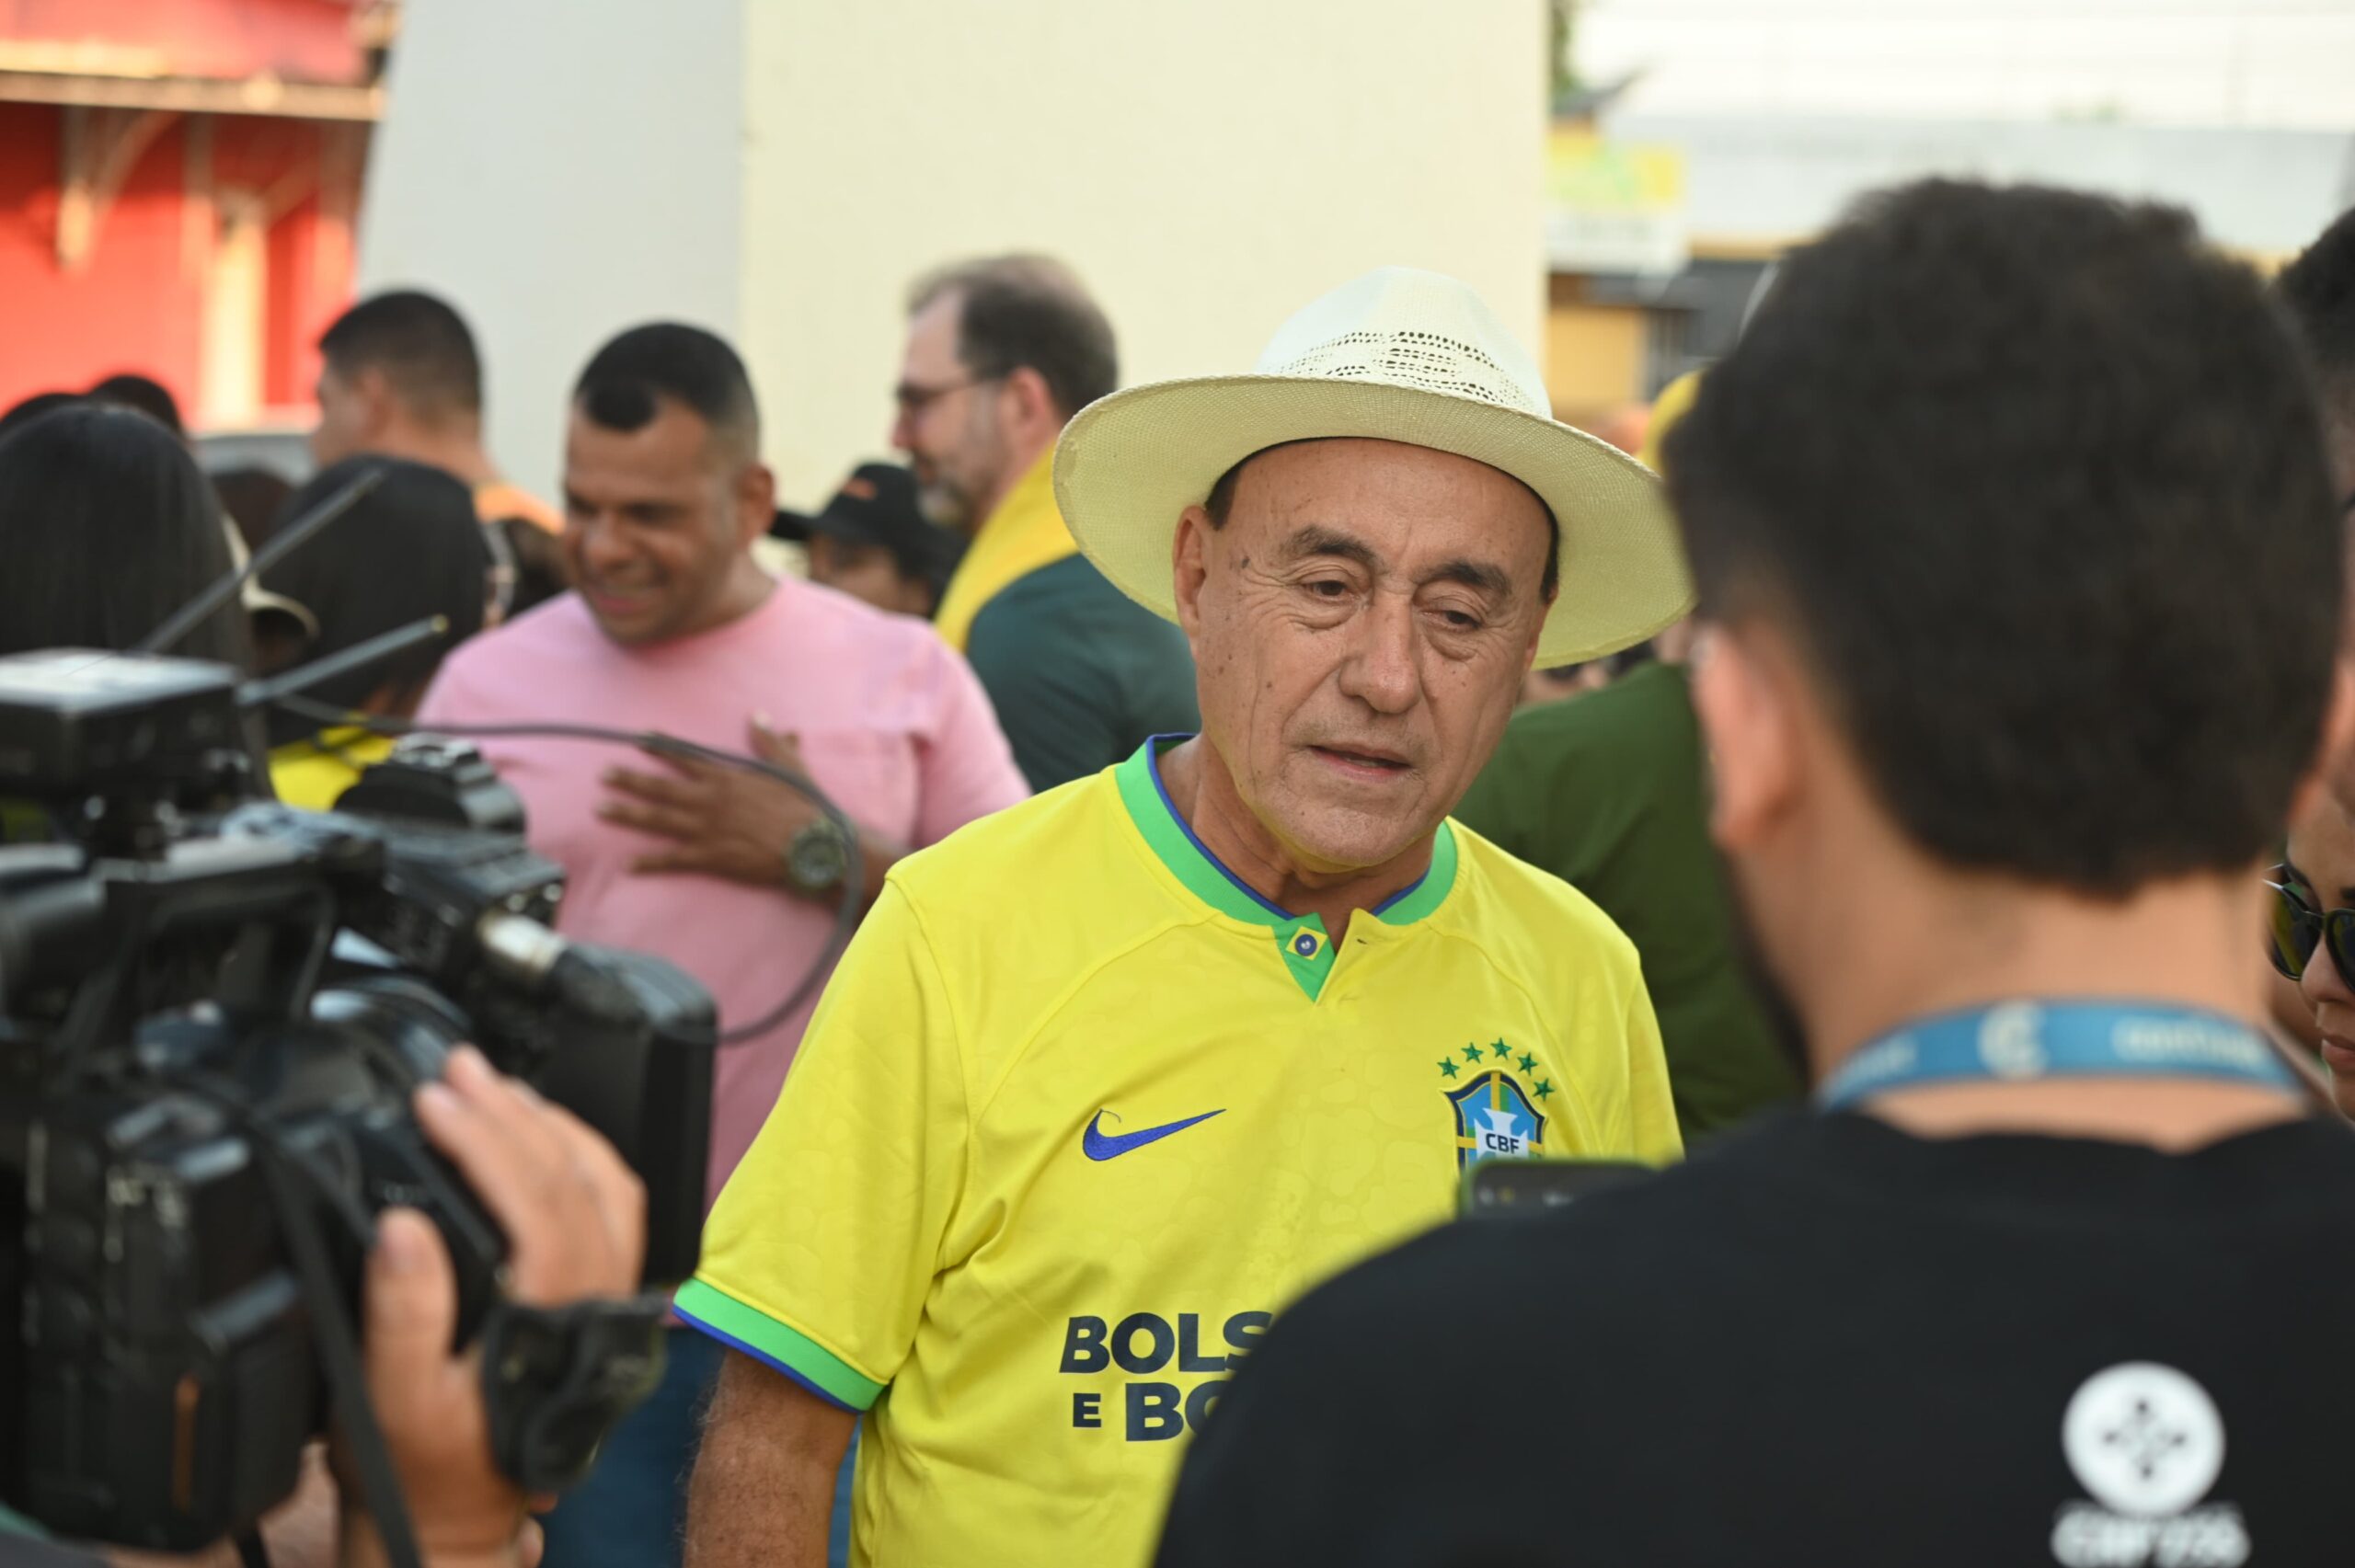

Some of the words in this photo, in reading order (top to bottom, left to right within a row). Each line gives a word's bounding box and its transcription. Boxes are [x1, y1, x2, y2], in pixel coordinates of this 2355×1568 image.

[1486, 1133, 1520, 1154] CBF
[1059, 1310, 1273, 1374] BOLS
[1073, 1392, 1101, 1427] E
